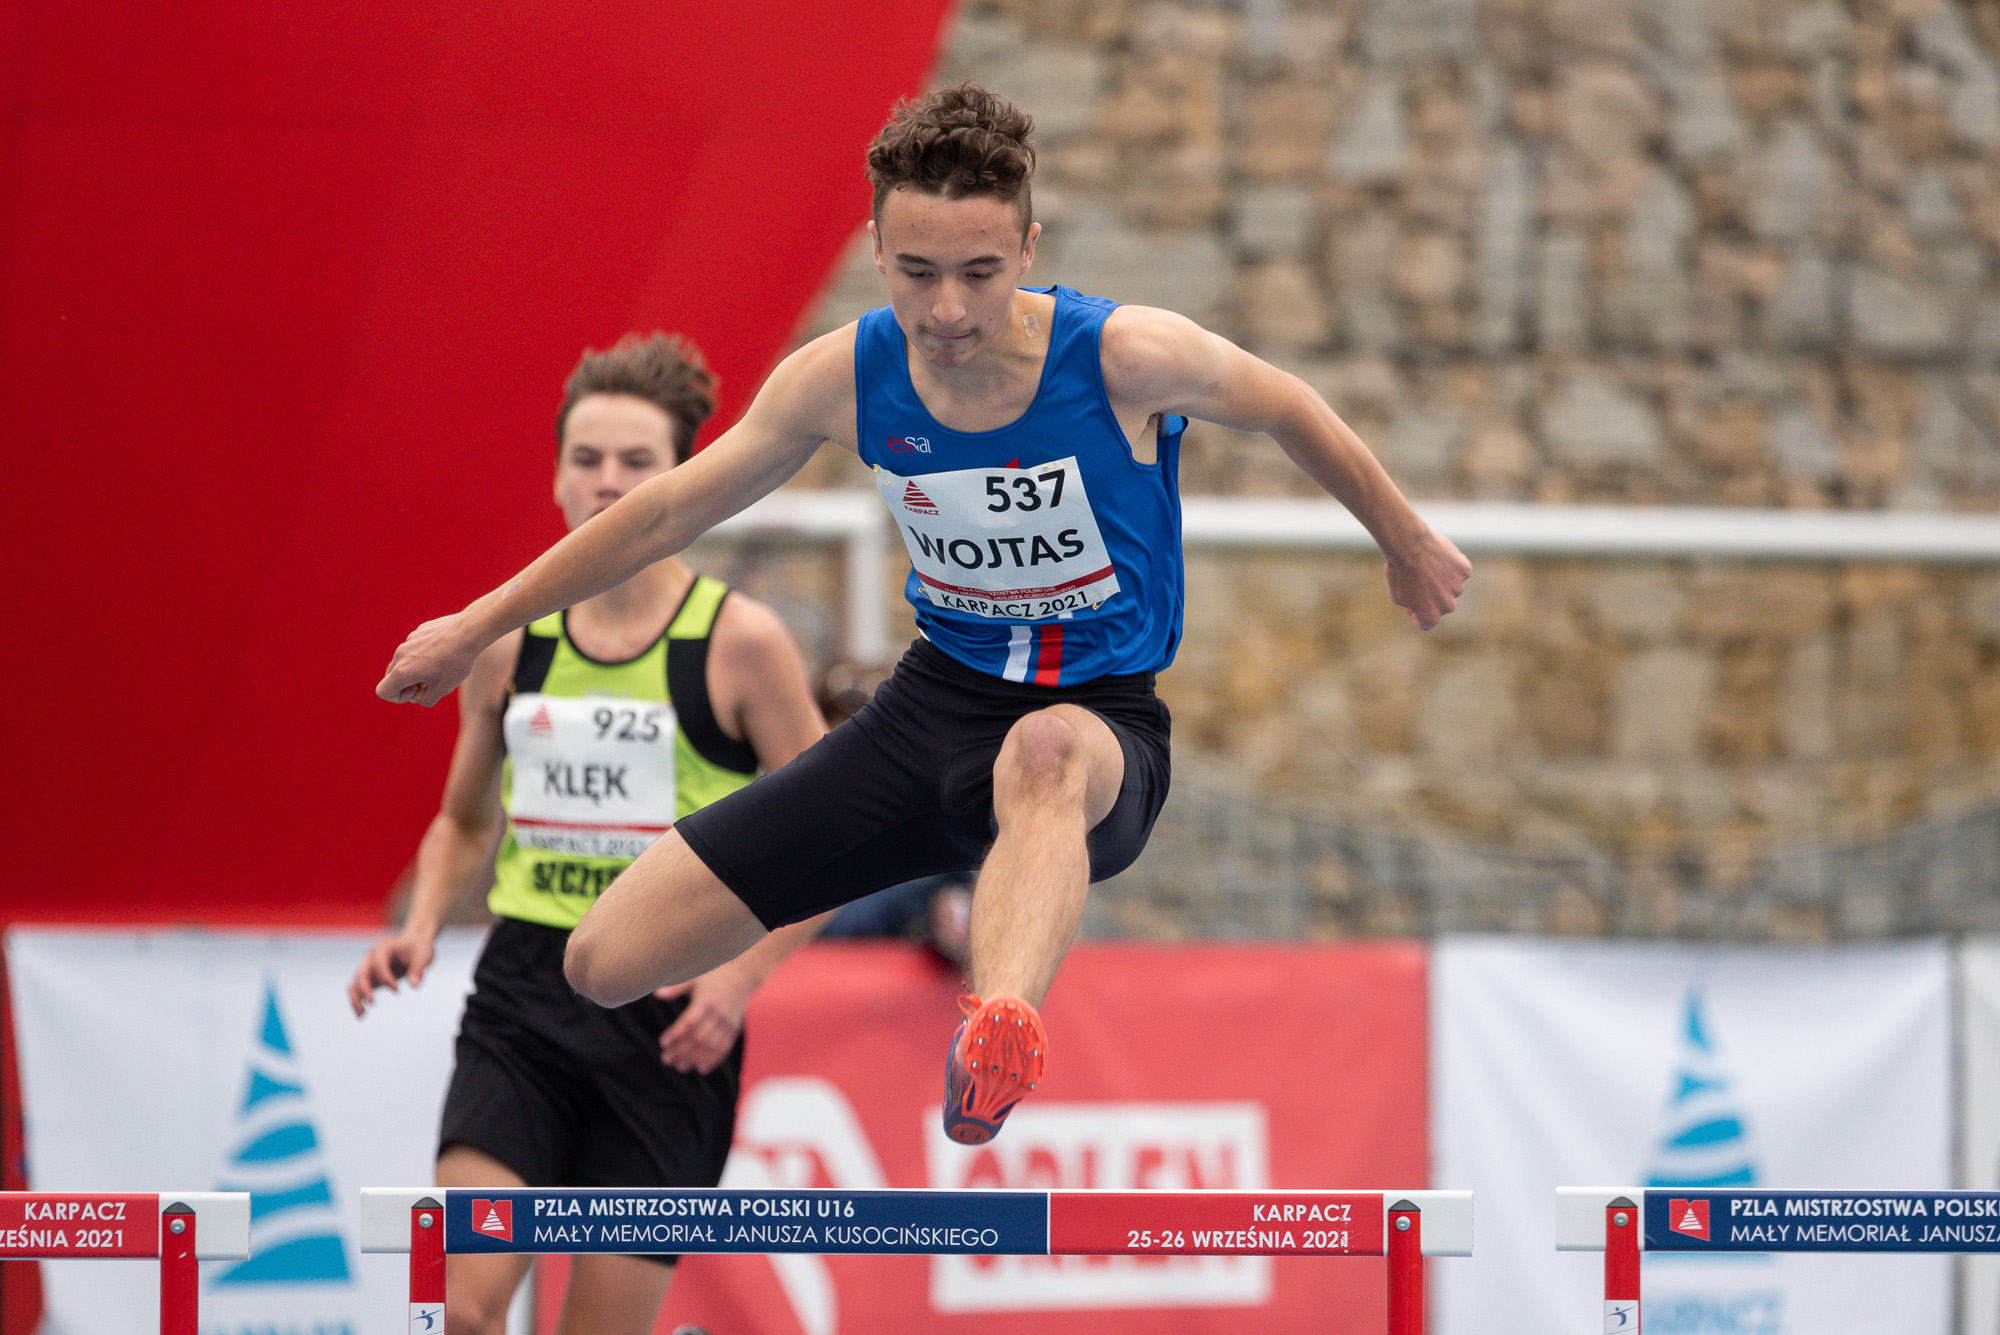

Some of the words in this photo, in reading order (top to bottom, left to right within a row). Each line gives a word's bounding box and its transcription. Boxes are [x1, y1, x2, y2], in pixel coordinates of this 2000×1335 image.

[985, 468, 1066, 513] 537
[904, 505, 940, 516] KARPACZ
[907, 524, 1085, 570] WOJTAS
[940, 593, 1034, 618] KARPACZ
[1038, 590, 1089, 615] 2021
[594, 708, 660, 743] 925
[544, 762, 628, 806] KLĘK
[25, 1202, 126, 1221] KARPACZ
[534, 1198, 585, 1217] PZLA
[589, 1198, 732, 1217] MISTRZOSTWA
[740, 1199, 810, 1217] POLSKI
[817, 1200, 855, 1218] U16
[1253, 1204, 1352, 1222] KARPACZ
[1731, 1198, 1777, 1217] PZLA
[1784, 1198, 1928, 1217] MISTRZOSTWA
[1934, 1199, 2000, 1217] POLSK
[75, 1229, 123, 1248] 2021
[534, 1224, 594, 1243] MAŁY
[600, 1224, 716, 1243] MEMORIAŁ
[723, 1225, 818, 1244] JANUSZA
[824, 1223, 999, 1247] KUSOCIŃSKIEGO
[1127, 1230, 1185, 1248] 25-26
[1192, 1225, 1296, 1248] WRZEŚNIA
[1302, 1230, 1349, 1249] 2021
[1731, 1224, 1789, 1242] MAŁY
[1796, 1224, 1912, 1243] MEMORIAŁ
